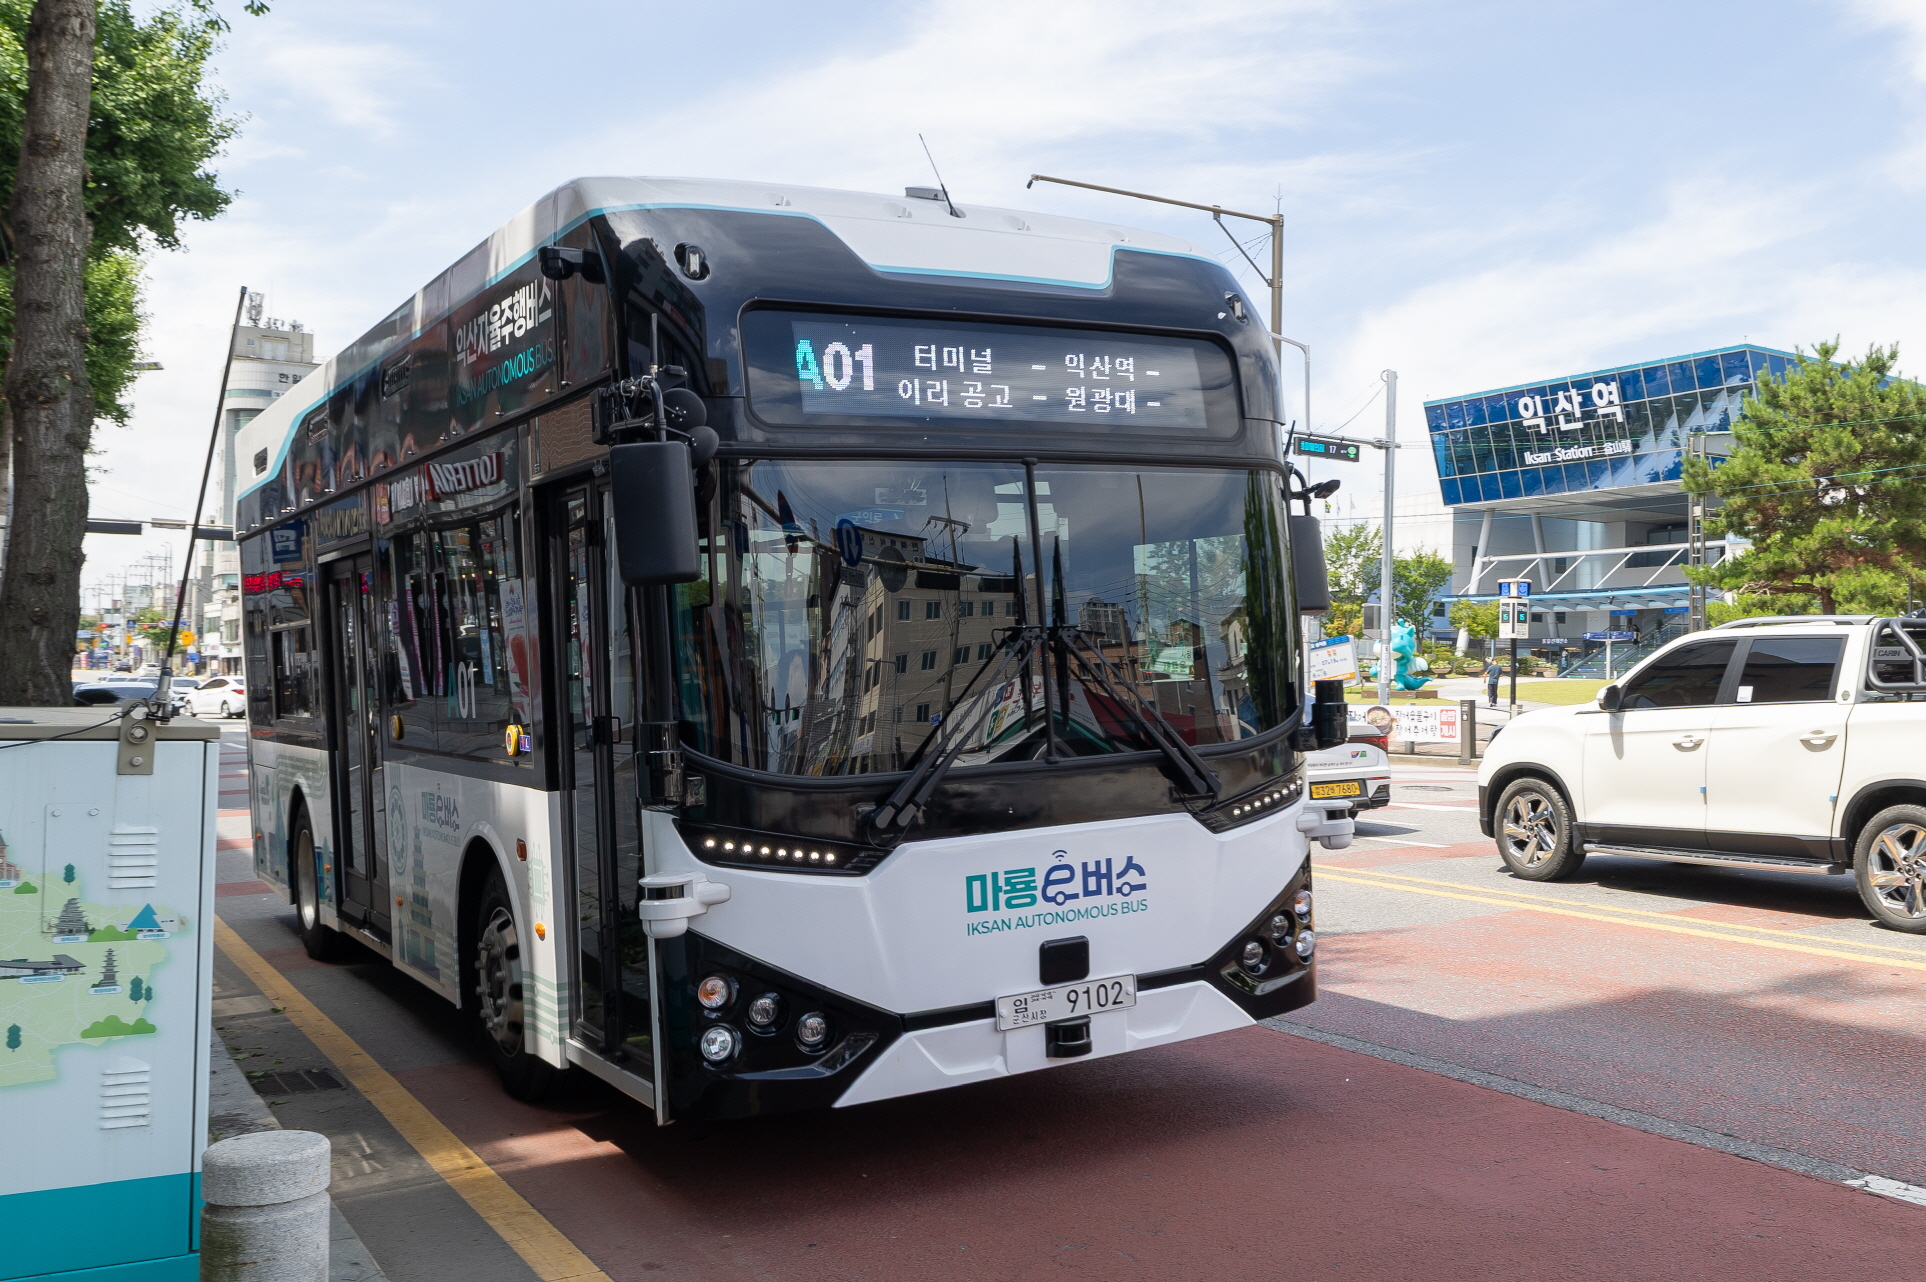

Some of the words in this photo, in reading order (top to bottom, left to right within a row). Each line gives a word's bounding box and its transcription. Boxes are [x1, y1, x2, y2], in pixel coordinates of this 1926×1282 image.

[456, 276, 552, 367] 익산자율주행버스
[457, 376, 477, 407] IKSAN
[477, 348, 535, 397] AUTONOMOUS
[795, 339, 875, 391] A01
[914, 344, 992, 375] 터미널
[1064, 352, 1136, 382] 익산역
[898, 377, 949, 407] 이리
[960, 381, 1013, 409] 공고
[1064, 386, 1137, 415] 원광대
[1518, 382, 1624, 434] 익산역
[1524, 451, 1552, 465] Iksan
[1555, 445, 1593, 461] Station
[447, 661, 476, 719] A01
[1336, 783, 1356, 795] 7680
[967, 917, 1011, 936] IKSAN
[1014, 903, 1118, 930] AUTONOMOUS
[1121, 899, 1148, 914] BUS
[1013, 997, 1028, 1014] 임
[1066, 981, 1124, 1013] 9102
